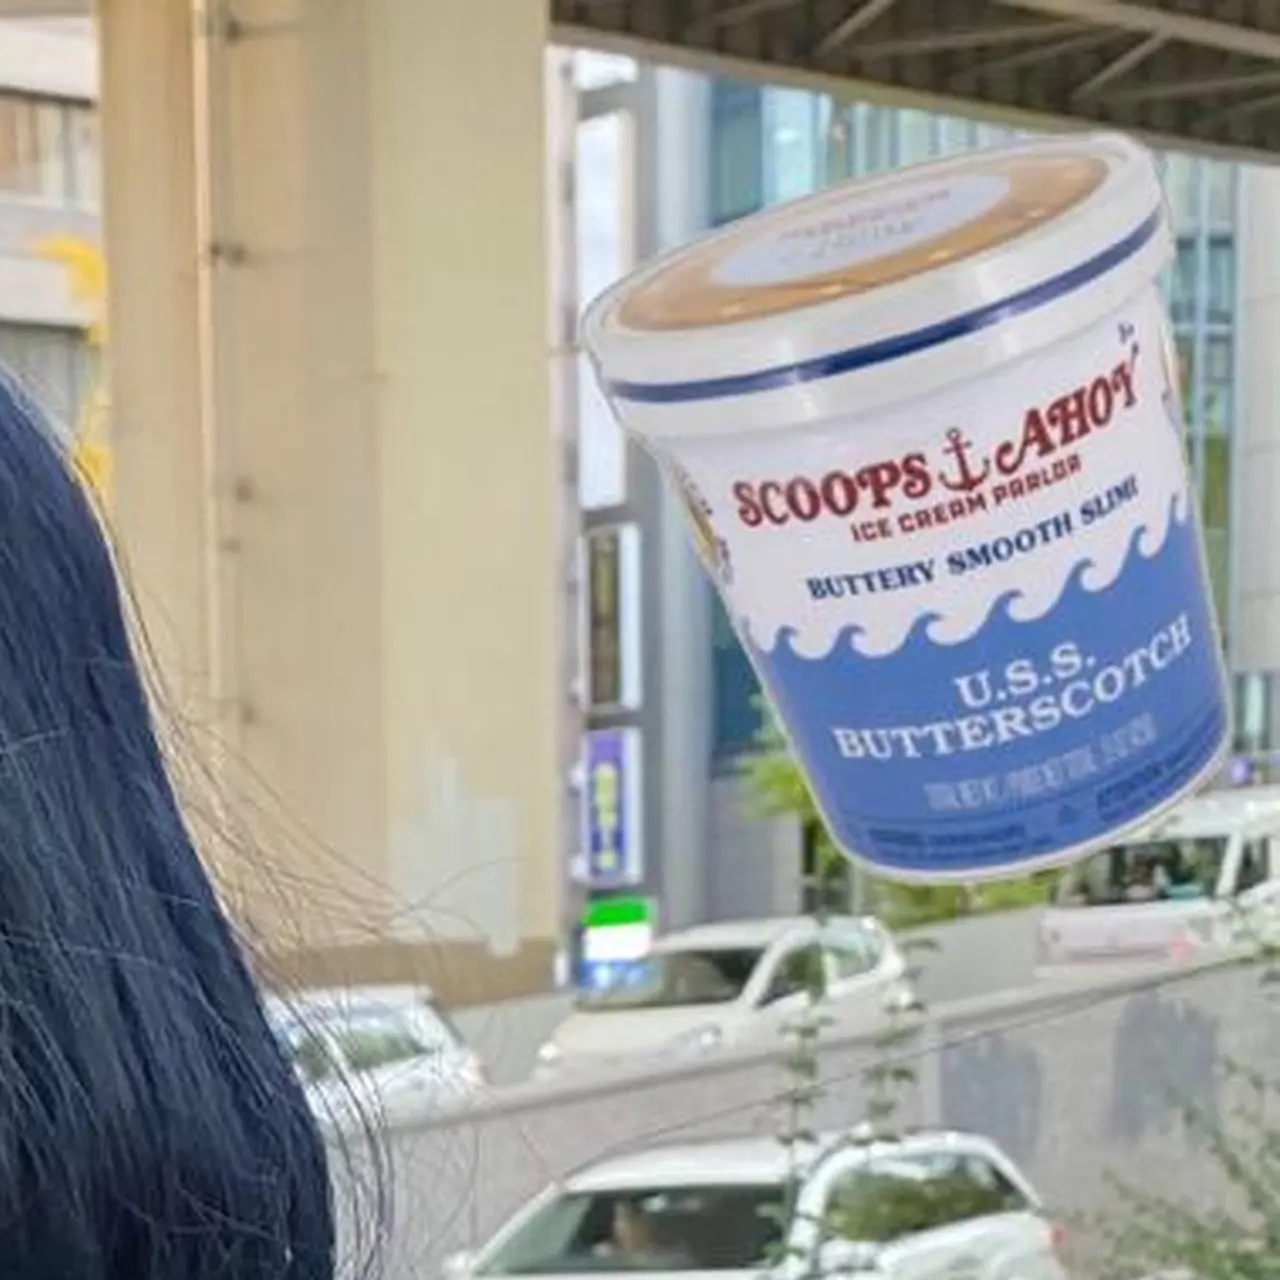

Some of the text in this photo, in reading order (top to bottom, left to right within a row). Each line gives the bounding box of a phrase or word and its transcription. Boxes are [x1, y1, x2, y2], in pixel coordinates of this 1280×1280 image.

[733, 344, 1139, 527] SCOOPS AHOY
[851, 454, 1083, 543] ICE CREAM PARLOR
[807, 558, 936, 599] BUTTERY
[946, 513, 1073, 574] SMOOTH
[830, 613, 1193, 759] BUTTERSCOTCH
[955, 642, 1096, 708] U.S.S.
